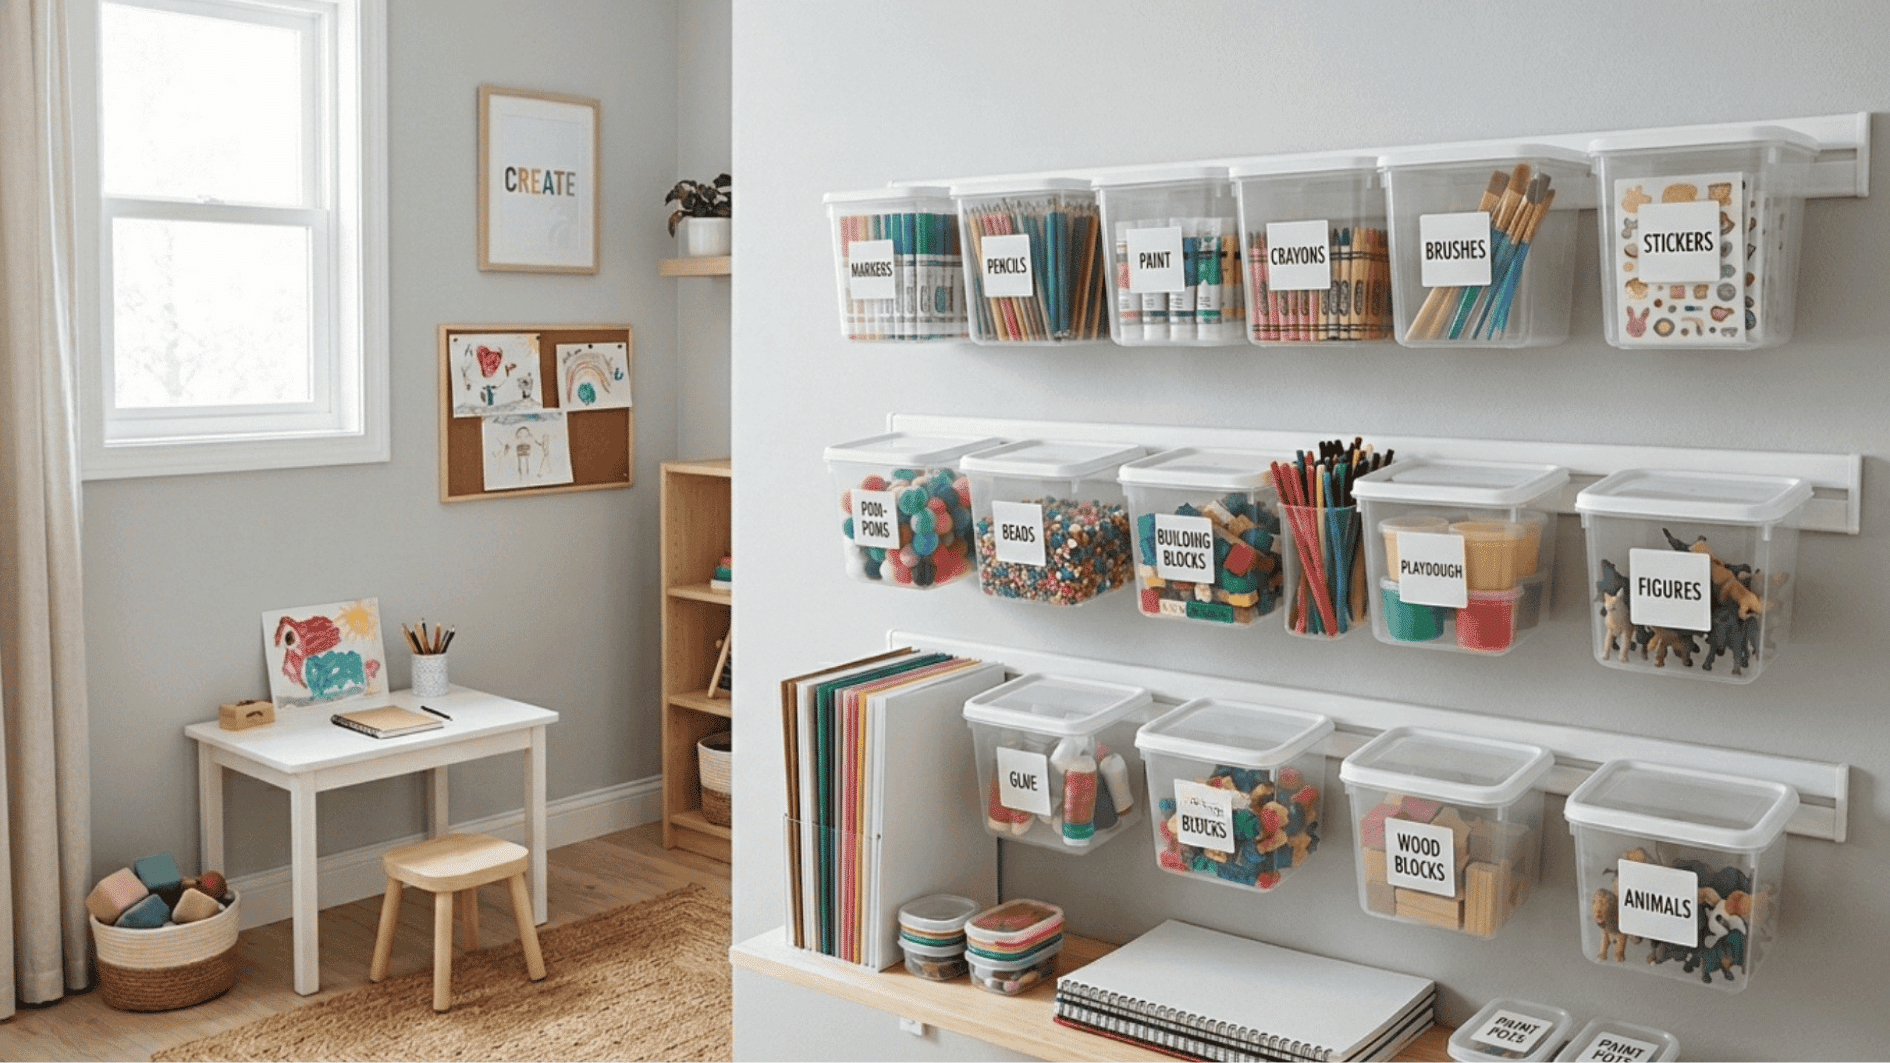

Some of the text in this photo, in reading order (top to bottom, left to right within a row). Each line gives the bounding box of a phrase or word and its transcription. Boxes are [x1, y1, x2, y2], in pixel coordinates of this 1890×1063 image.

[504, 166, 577, 197] CREATE
[1425, 239, 1486, 261] BRUSHES
[1643, 231, 1714, 254] STICKERS
[987, 256, 1027, 274] PENCILS
[1139, 251, 1171, 269] PAINT
[861, 520, 890, 539] POMS
[1157, 528, 1211, 549] BUILDING
[1163, 549, 1206, 570] BLOCKS
[1401, 559, 1463, 579] PLAYDOUGH
[1638, 576, 1702, 601] FIGURES
[1397, 832, 1441, 857] WOOD
[1394, 855, 1446, 882] BLOCKS
[1624, 888, 1692, 919] ANIMALS
[1598, 1039, 1645, 1059] PAINT
